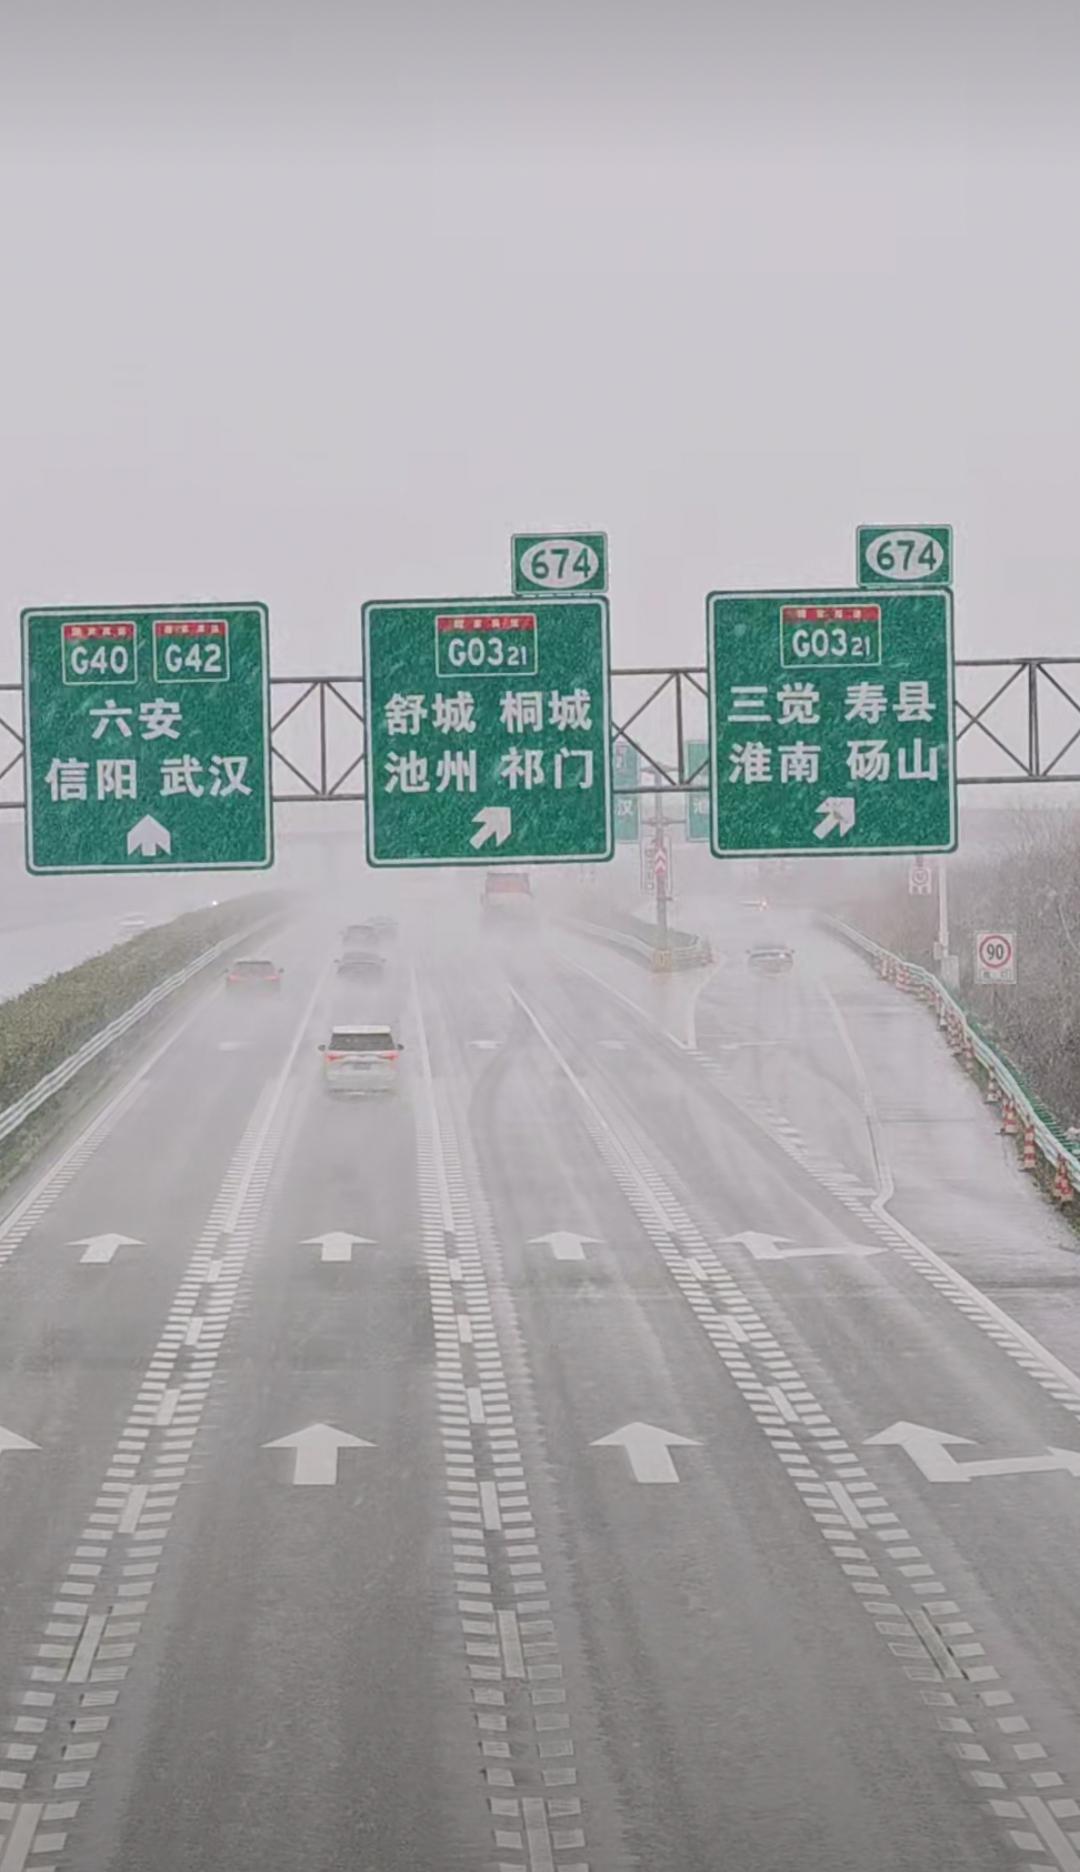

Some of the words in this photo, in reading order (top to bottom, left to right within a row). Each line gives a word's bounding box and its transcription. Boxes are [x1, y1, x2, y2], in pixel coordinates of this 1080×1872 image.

[531, 549, 591, 579] 674
[876, 540, 937, 571] 674
[71, 646, 129, 675] G40
[165, 644, 222, 673] G42
[89, 698, 183, 741] 六安
[384, 692, 476, 736] 舒城
[500, 689, 592, 734] 桐城
[727, 684, 820, 725] 三觉
[845, 681, 937, 724] 寿县
[45, 758, 137, 802] 信阳
[160, 755, 252, 798] 武汉
[384, 750, 477, 794] 池州
[500, 747, 592, 791] 祁门
[729, 742, 821, 785] 淮南
[847, 739, 939, 783] 砀山
[987, 943, 1004, 961] 90
